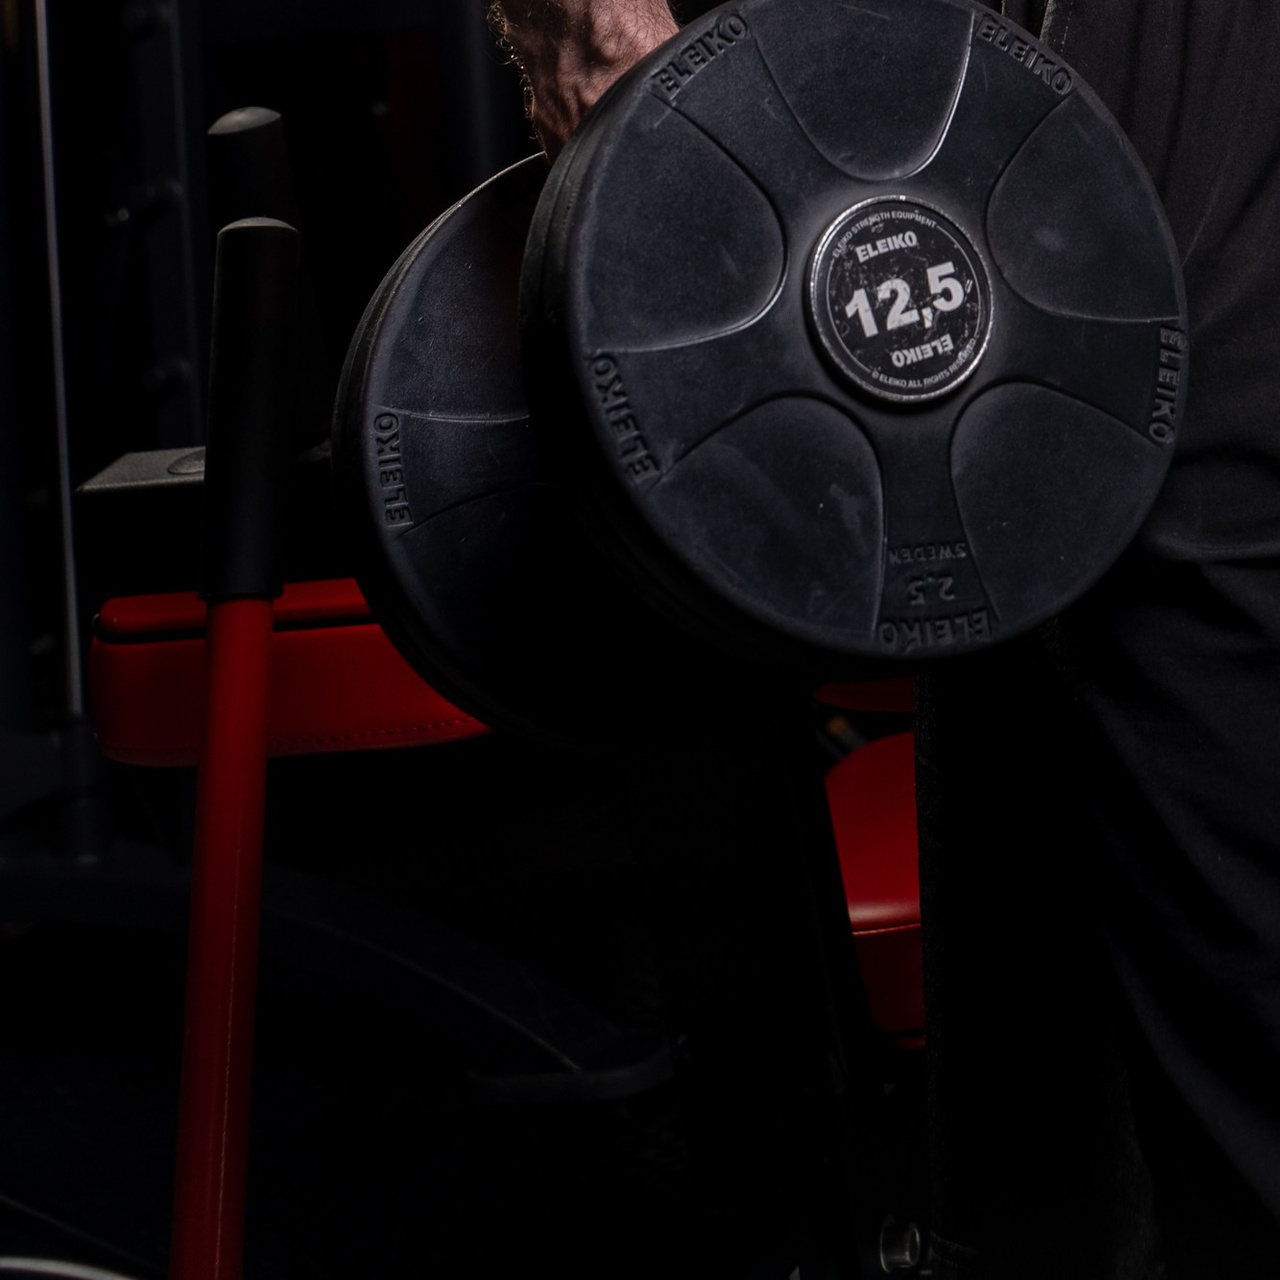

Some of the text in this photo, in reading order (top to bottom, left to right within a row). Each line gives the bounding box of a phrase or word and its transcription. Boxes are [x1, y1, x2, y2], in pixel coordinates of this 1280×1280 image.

[650, 12, 748, 101] ELEIKO
[976, 12, 1073, 96] ELEIKO
[855, 230, 918, 263] ELEIKO
[845, 261, 965, 338] 12,5
[891, 333, 954, 368] ELEIKO
[907, 379, 923, 388] ALL
[1148, 324, 1187, 443] ELEIKO
[590, 354, 661, 483] ELEIKO
[374, 413, 414, 527] ELEIKO
[888, 541, 967, 564] SWEDEN
[878, 607, 992, 655] ELEIKO
